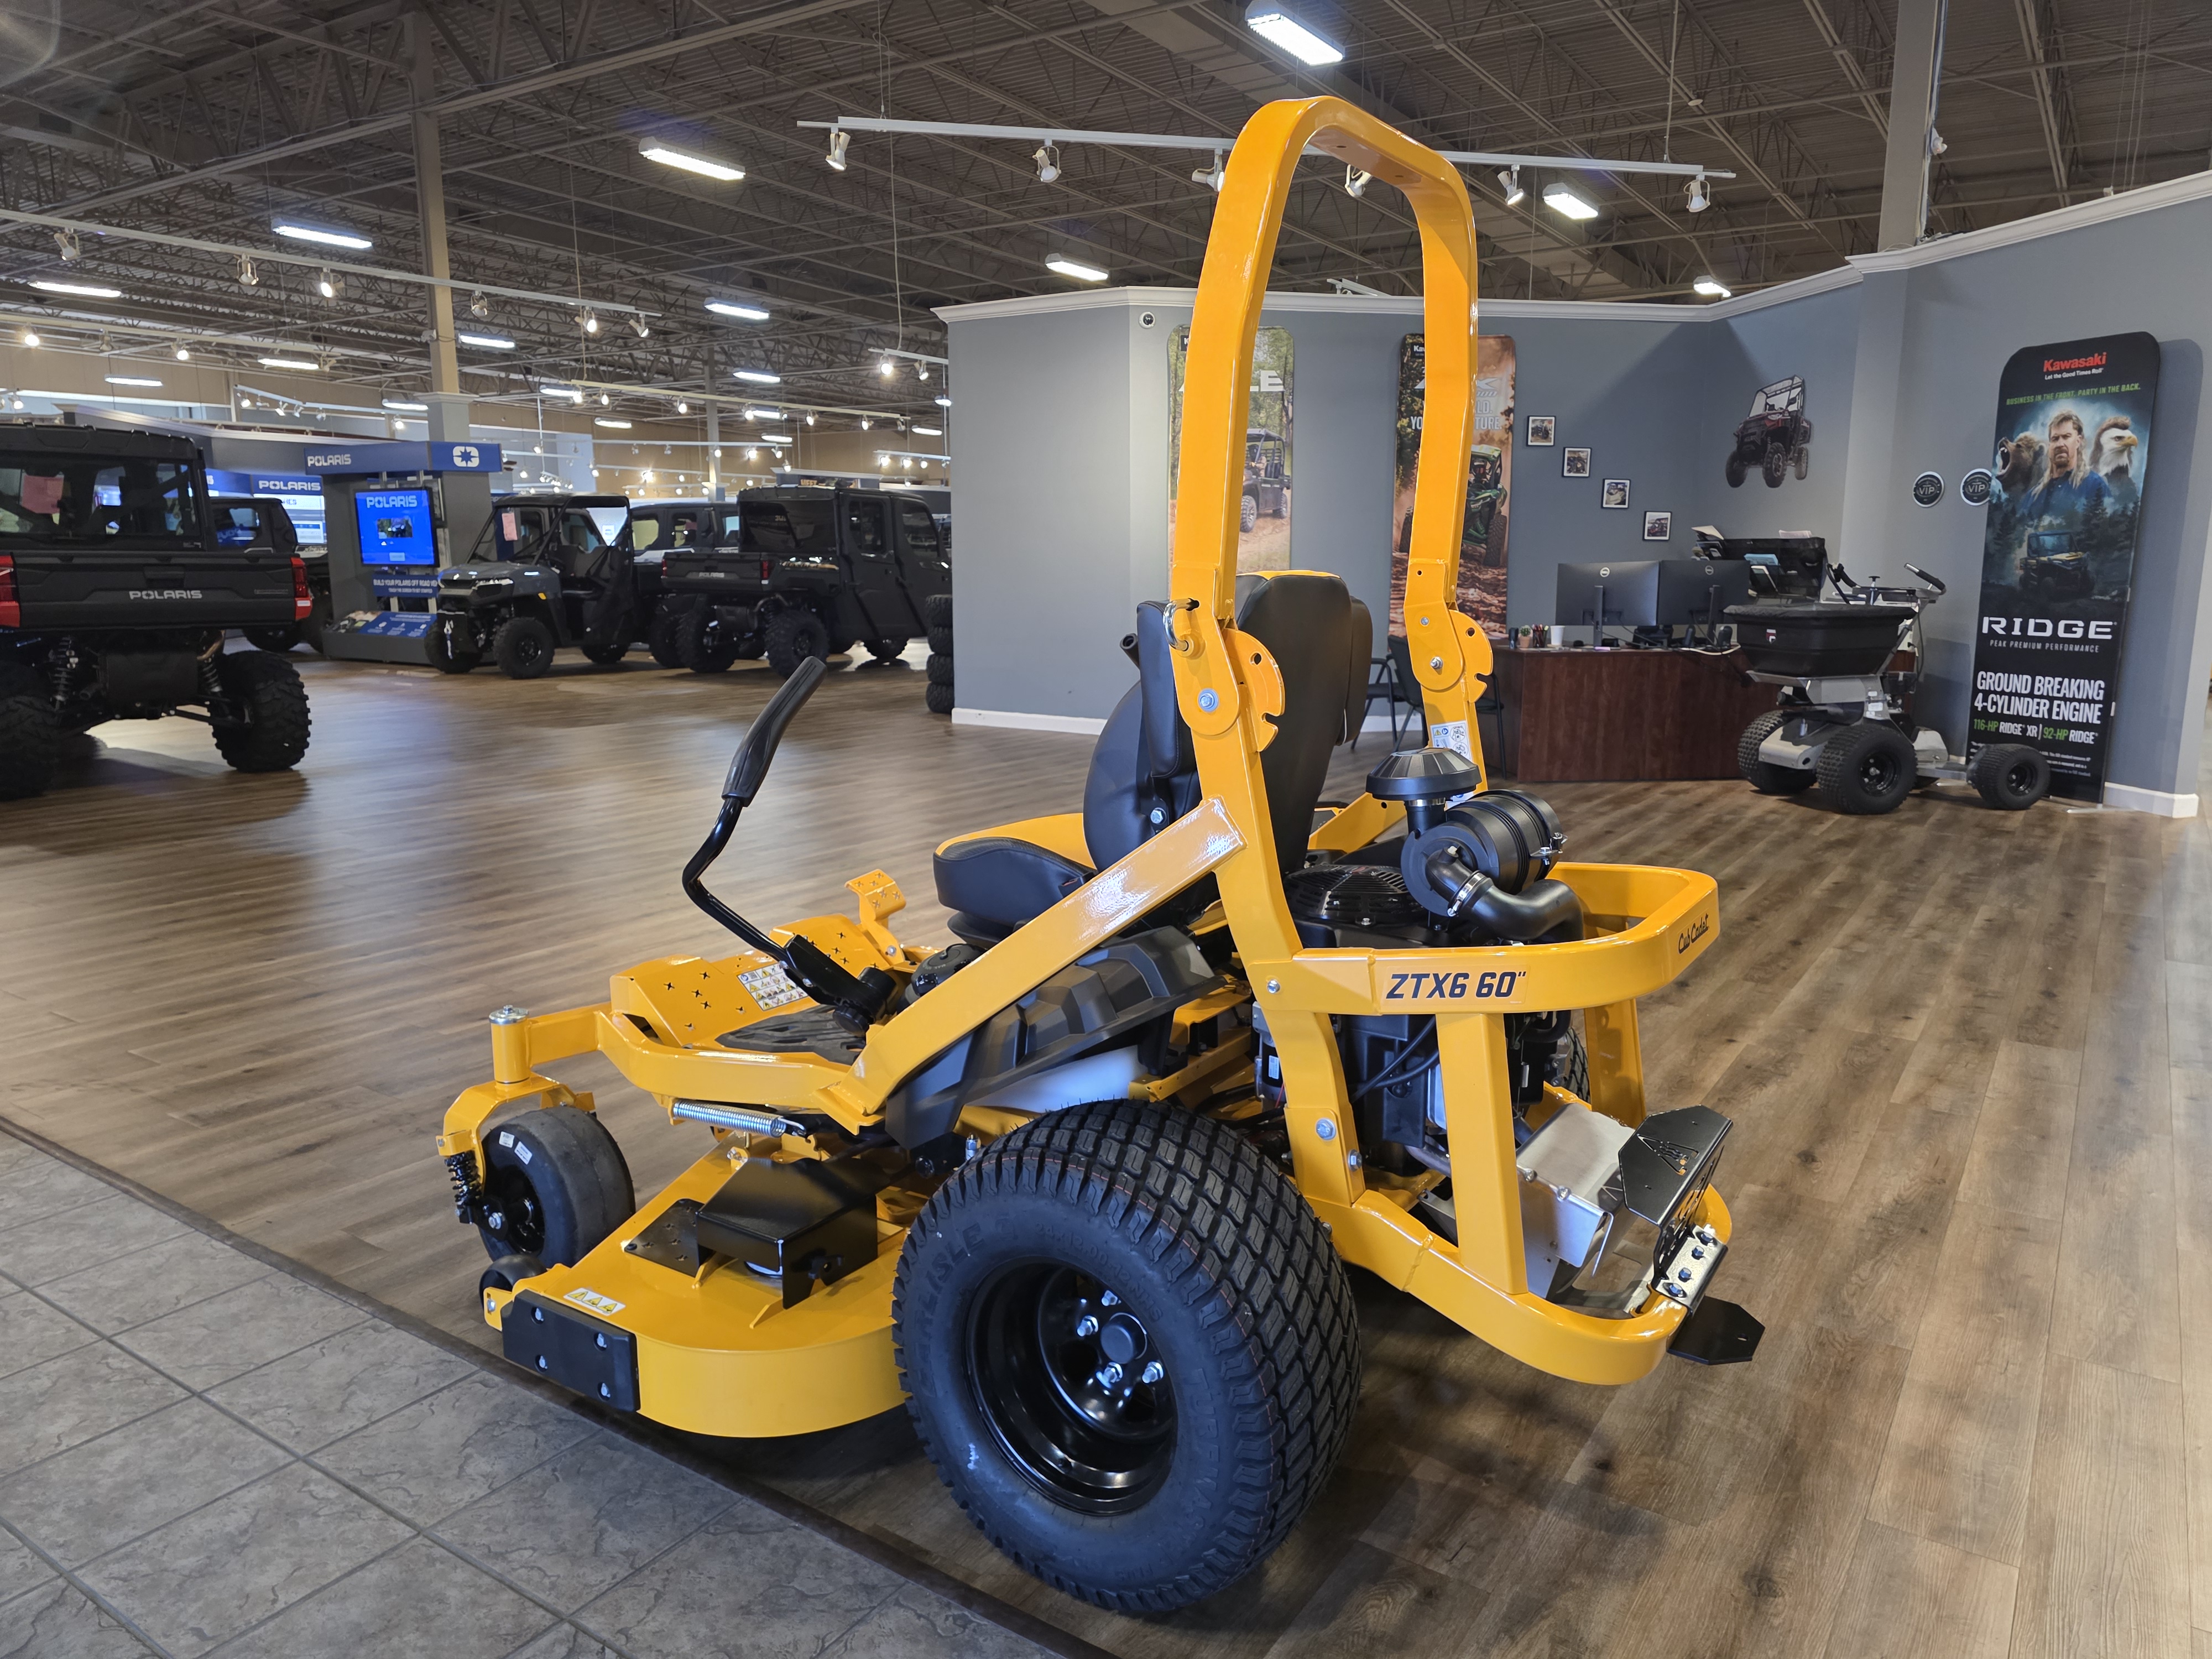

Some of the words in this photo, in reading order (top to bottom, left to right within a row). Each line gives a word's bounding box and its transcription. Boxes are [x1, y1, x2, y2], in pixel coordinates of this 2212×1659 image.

[2043, 352, 2107, 372] Kawasaki
[2006, 395, 2034, 405] BUSINESS
[2078, 388, 2098, 396] PARTY
[2107, 385, 2120, 393] THE
[2121, 383, 2141, 392] BACK.
[307, 454, 352, 467] POLARIS
[258, 480, 321, 491] POLARIS
[1919, 486, 1936, 495] VIP
[1968, 484, 1986, 493] VIP
[366, 495, 418, 509] POLARIS
[129, 590, 202, 600] POLARIS
[1982, 617, 2112, 639] RIDGE
[1990, 639, 2006, 648] PEAK
[2010, 641, 2042, 649] PREMIUM
[2045, 643, 2100, 653] PERFORMANCE
[1977, 671, 2032, 694] GROUND
[2033, 676, 2105, 701] BREAKING
[1974, 692, 2050, 719] 4-CYLINDER
[2052, 700, 2103, 724] ENGINE
[1974, 719, 1999, 732] 116-HP
[2026, 724, 2038, 737] XR
[2043, 727, 2069, 740] 92-HP
[1678, 928, 1691, 954] Cub
[1691, 912, 1709, 943] Cadet
[1386, 972, 1470, 999] ZTX6
[1475, 971, 1526, 998] 60"
